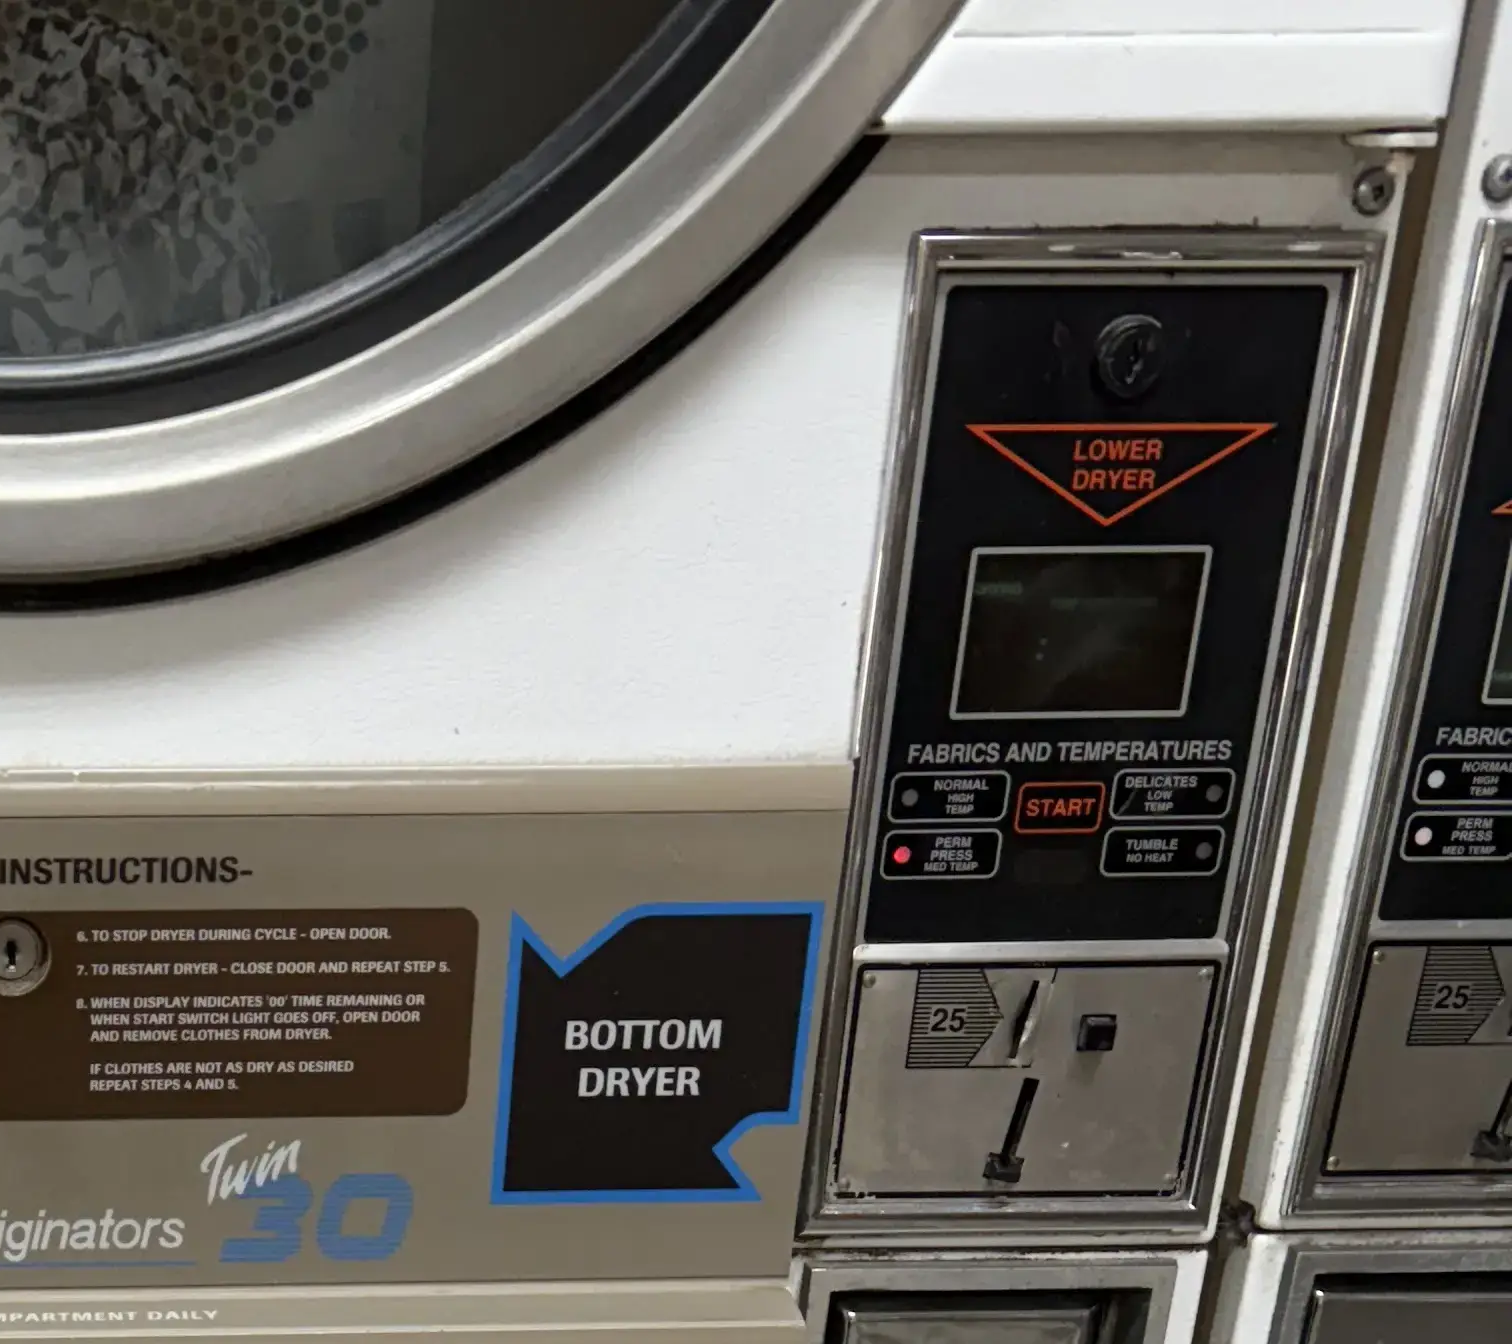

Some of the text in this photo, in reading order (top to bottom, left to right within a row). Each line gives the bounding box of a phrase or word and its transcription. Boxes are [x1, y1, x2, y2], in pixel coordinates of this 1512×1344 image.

[1072, 439, 1164, 462] LOWER
[1071, 468, 1157, 491] DRYER
[907, 740, 1233, 764] FABRICS AND TEMPERATURES
[933, 779, 989, 791] NORMAL
[1124, 776, 1199, 789] DELICATES
[1025, 798, 1096, 817] START
[935, 836, 973, 848] PERM
[1450, 830, 1493, 842] PRESS
[1125, 838, 1179, 851] TUMBLE
[930, 850, 973, 861] PRESS
[1125, 853, 1174, 863] NO HEAT
[91, 929, 110, 942] TO
[112, 929, 148, 942] STOP
[150, 929, 196, 941] DRYER
[198, 928, 252, 941] DURING
[254, 928, 297, 941] CYCLE
[309, 927, 346, 940] OPEN
[348, 927, 392, 940] DOOR.
[91, 963, 109, 976] TO
[112, 963, 171, 975] RESTART
[173, 962, 218, 975] DRYER
[230, 961, 273, 975] CLOSE
[276, 961, 316, 974] DOOR
[318, 961, 349, 973] AND
[351, 961, 401, 973] REPEAT
[403, 960, 436, 973] STEP
[90, 997, 130, 1009] WHEN
[133, 996, 190, 1009] DISPLAY
[193, 995, 263, 1008] INDICATES
[291, 995, 323, 1007] TIME
[326, 994, 403, 1007] REMAINING
[405, 993, 425, 1006] OR
[1434, 985, 1471, 1010] 25
[90, 1010, 421, 1025] WHEN START SWITCH LIGHT GOES OFF, OPEN DOOR
[929, 1007, 968, 1034] 25
[90, 1028, 332, 1042] AND REMOVE CLOTHES FROM DRYER.
[564, 1018, 723, 1051] BOTTOM
[90, 1060, 354, 1075] IF CLOTHES ARE NOT AS DRY AS DESIRED
[89, 1079, 138, 1091] REPEAT
[141, 1078, 181, 1091] STEPS
[195, 1078, 225, 1090] AND
[577, 1066, 701, 1098] DRYER
[201, 1132, 302, 1204] Twin
[220, 1172, 415, 1265] 30
[146, 1308, 220, 1321] DAILY
